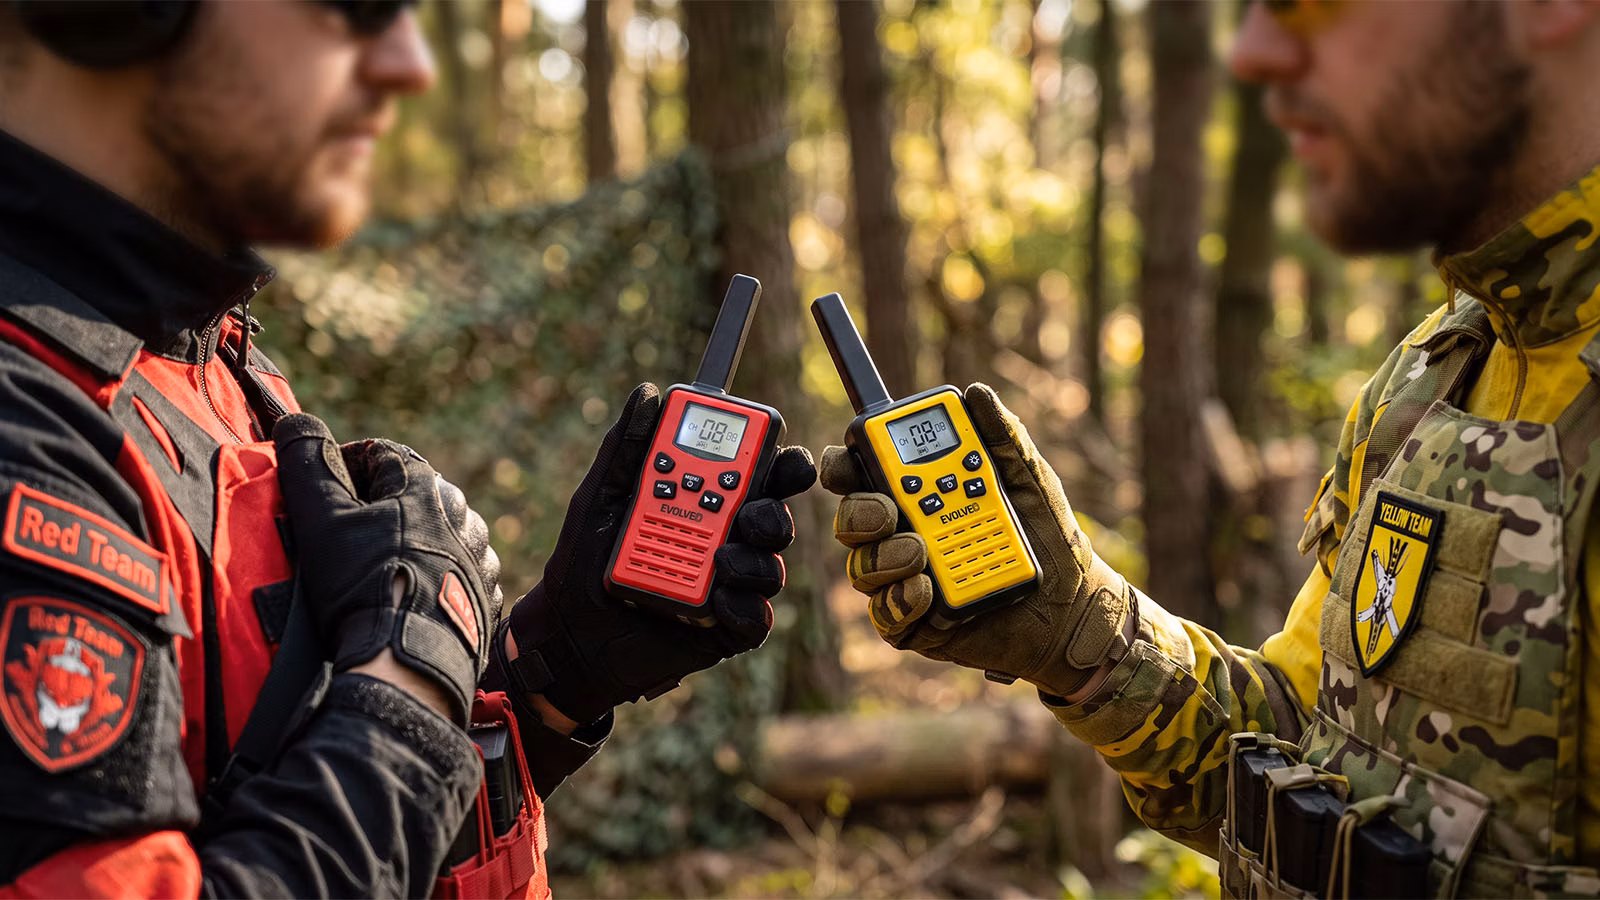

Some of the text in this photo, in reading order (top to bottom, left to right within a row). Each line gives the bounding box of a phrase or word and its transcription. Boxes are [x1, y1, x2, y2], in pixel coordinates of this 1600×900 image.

[699, 419, 728, 443] 08
[909, 420, 937, 446] 08
[660, 504, 702, 521] EVOLVED
[940, 503, 980, 524] EVOLVED
[1380, 502, 1432, 537] YELLOW TEAM
[20, 505, 156, 593] Red Team
